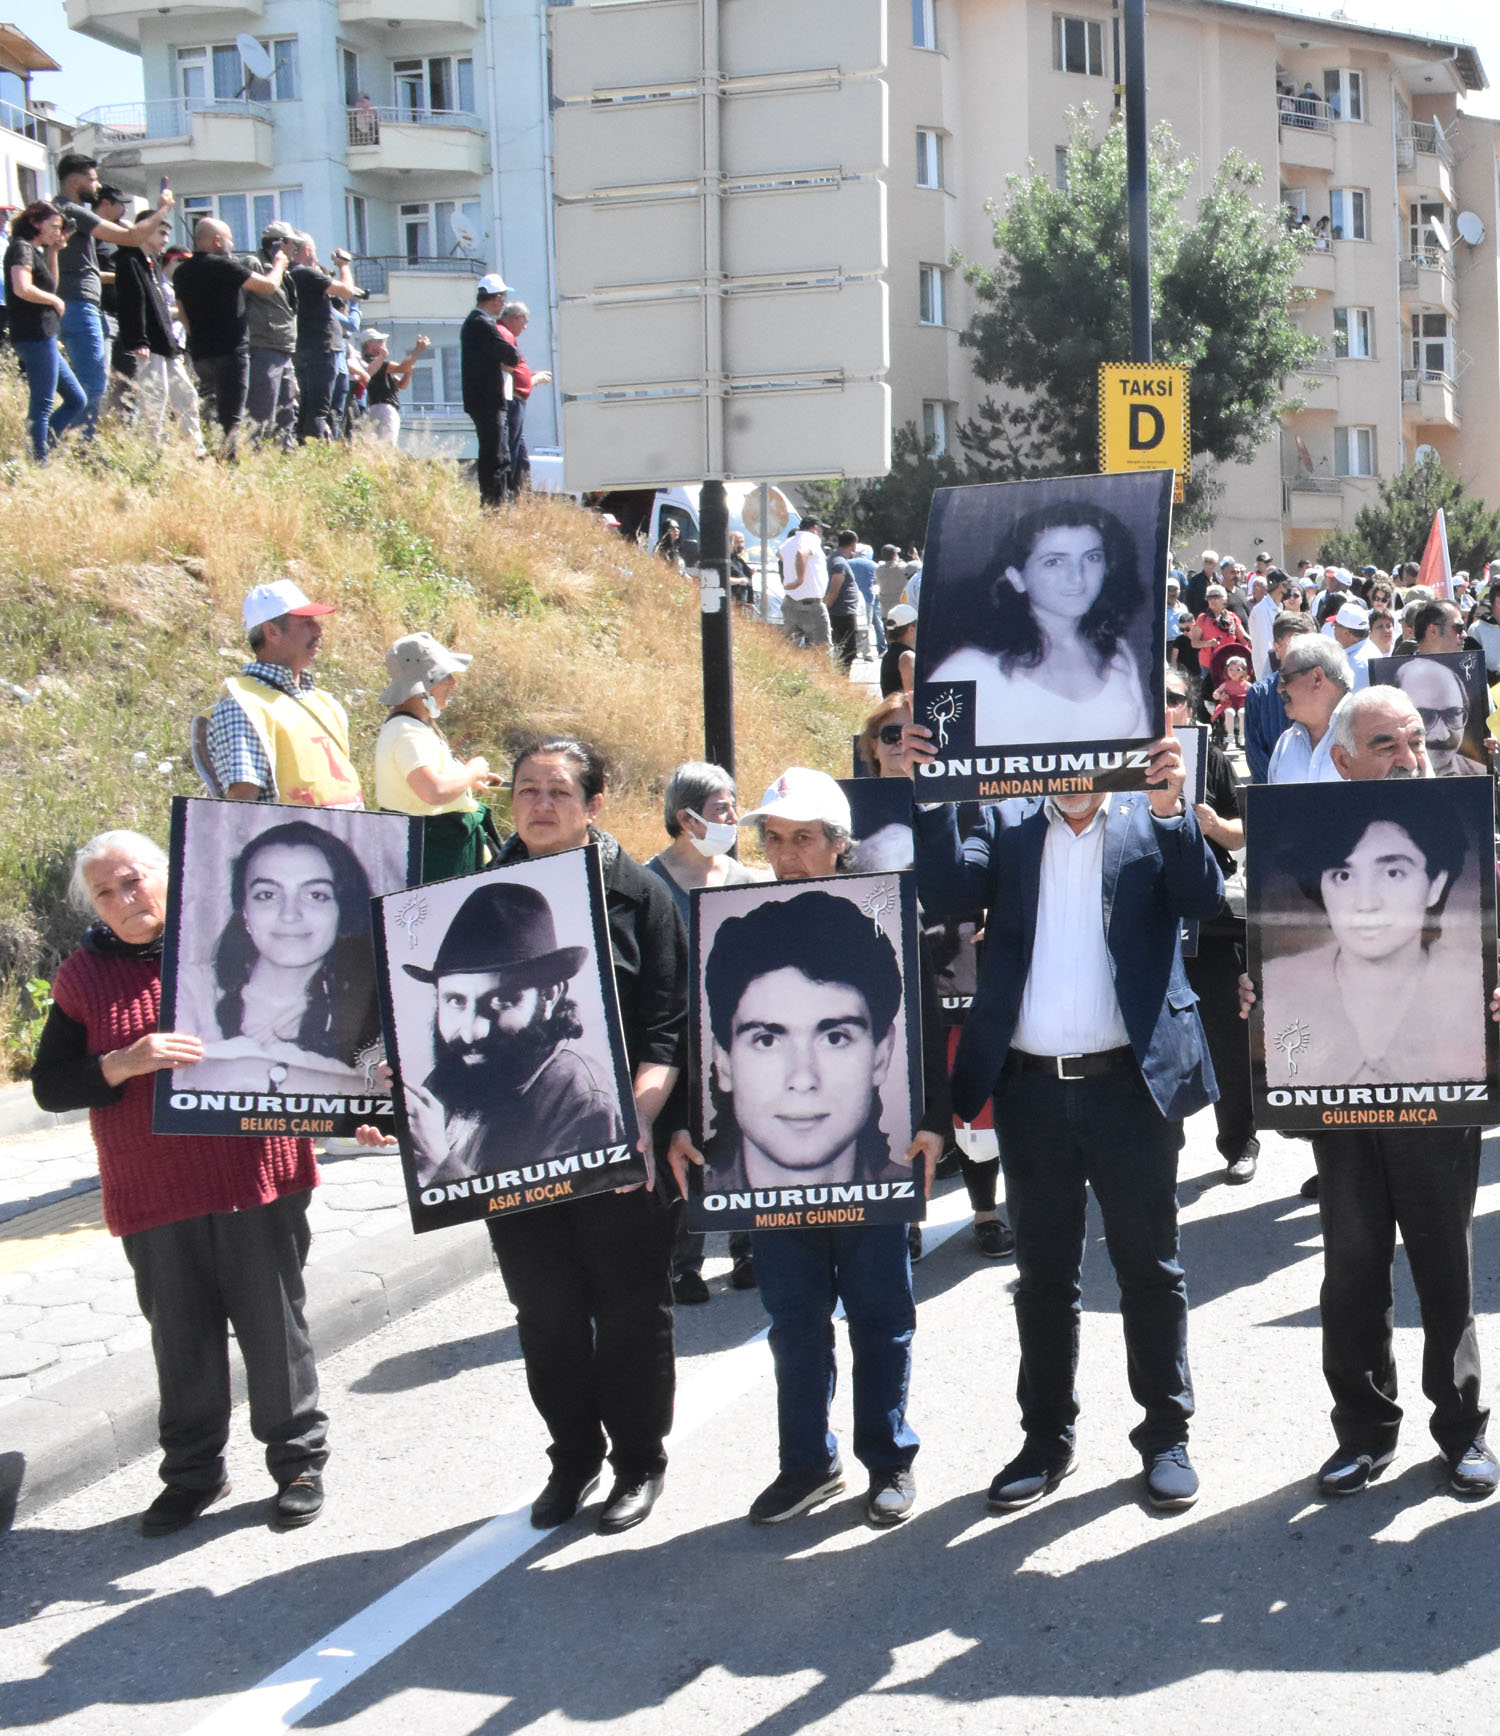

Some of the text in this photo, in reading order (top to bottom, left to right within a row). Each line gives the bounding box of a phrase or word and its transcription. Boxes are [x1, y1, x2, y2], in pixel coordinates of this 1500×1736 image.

[1119, 376, 1173, 397] TAKSİ
[1129, 403, 1165, 450] D
[919, 750, 1151, 778] ONURUMUZ
[979, 774, 1093, 796] HANDAN METİN
[169, 1093, 395, 1116] ONURUMUZ
[1266, 1084, 1489, 1107] ONURUMUZ
[240, 1117, 335, 1136] BELKIS ÇAKIR
[1322, 1107, 1438, 1125] GÜLENDER AKÇA
[420, 1143, 632, 1206] ONURUMUZ
[488, 1180, 574, 1212] ASAF KOÇAK
[703, 1181, 916, 1212] ONURUMUZ
[755, 1205, 865, 1228] MURAT GÜNDÜZ
